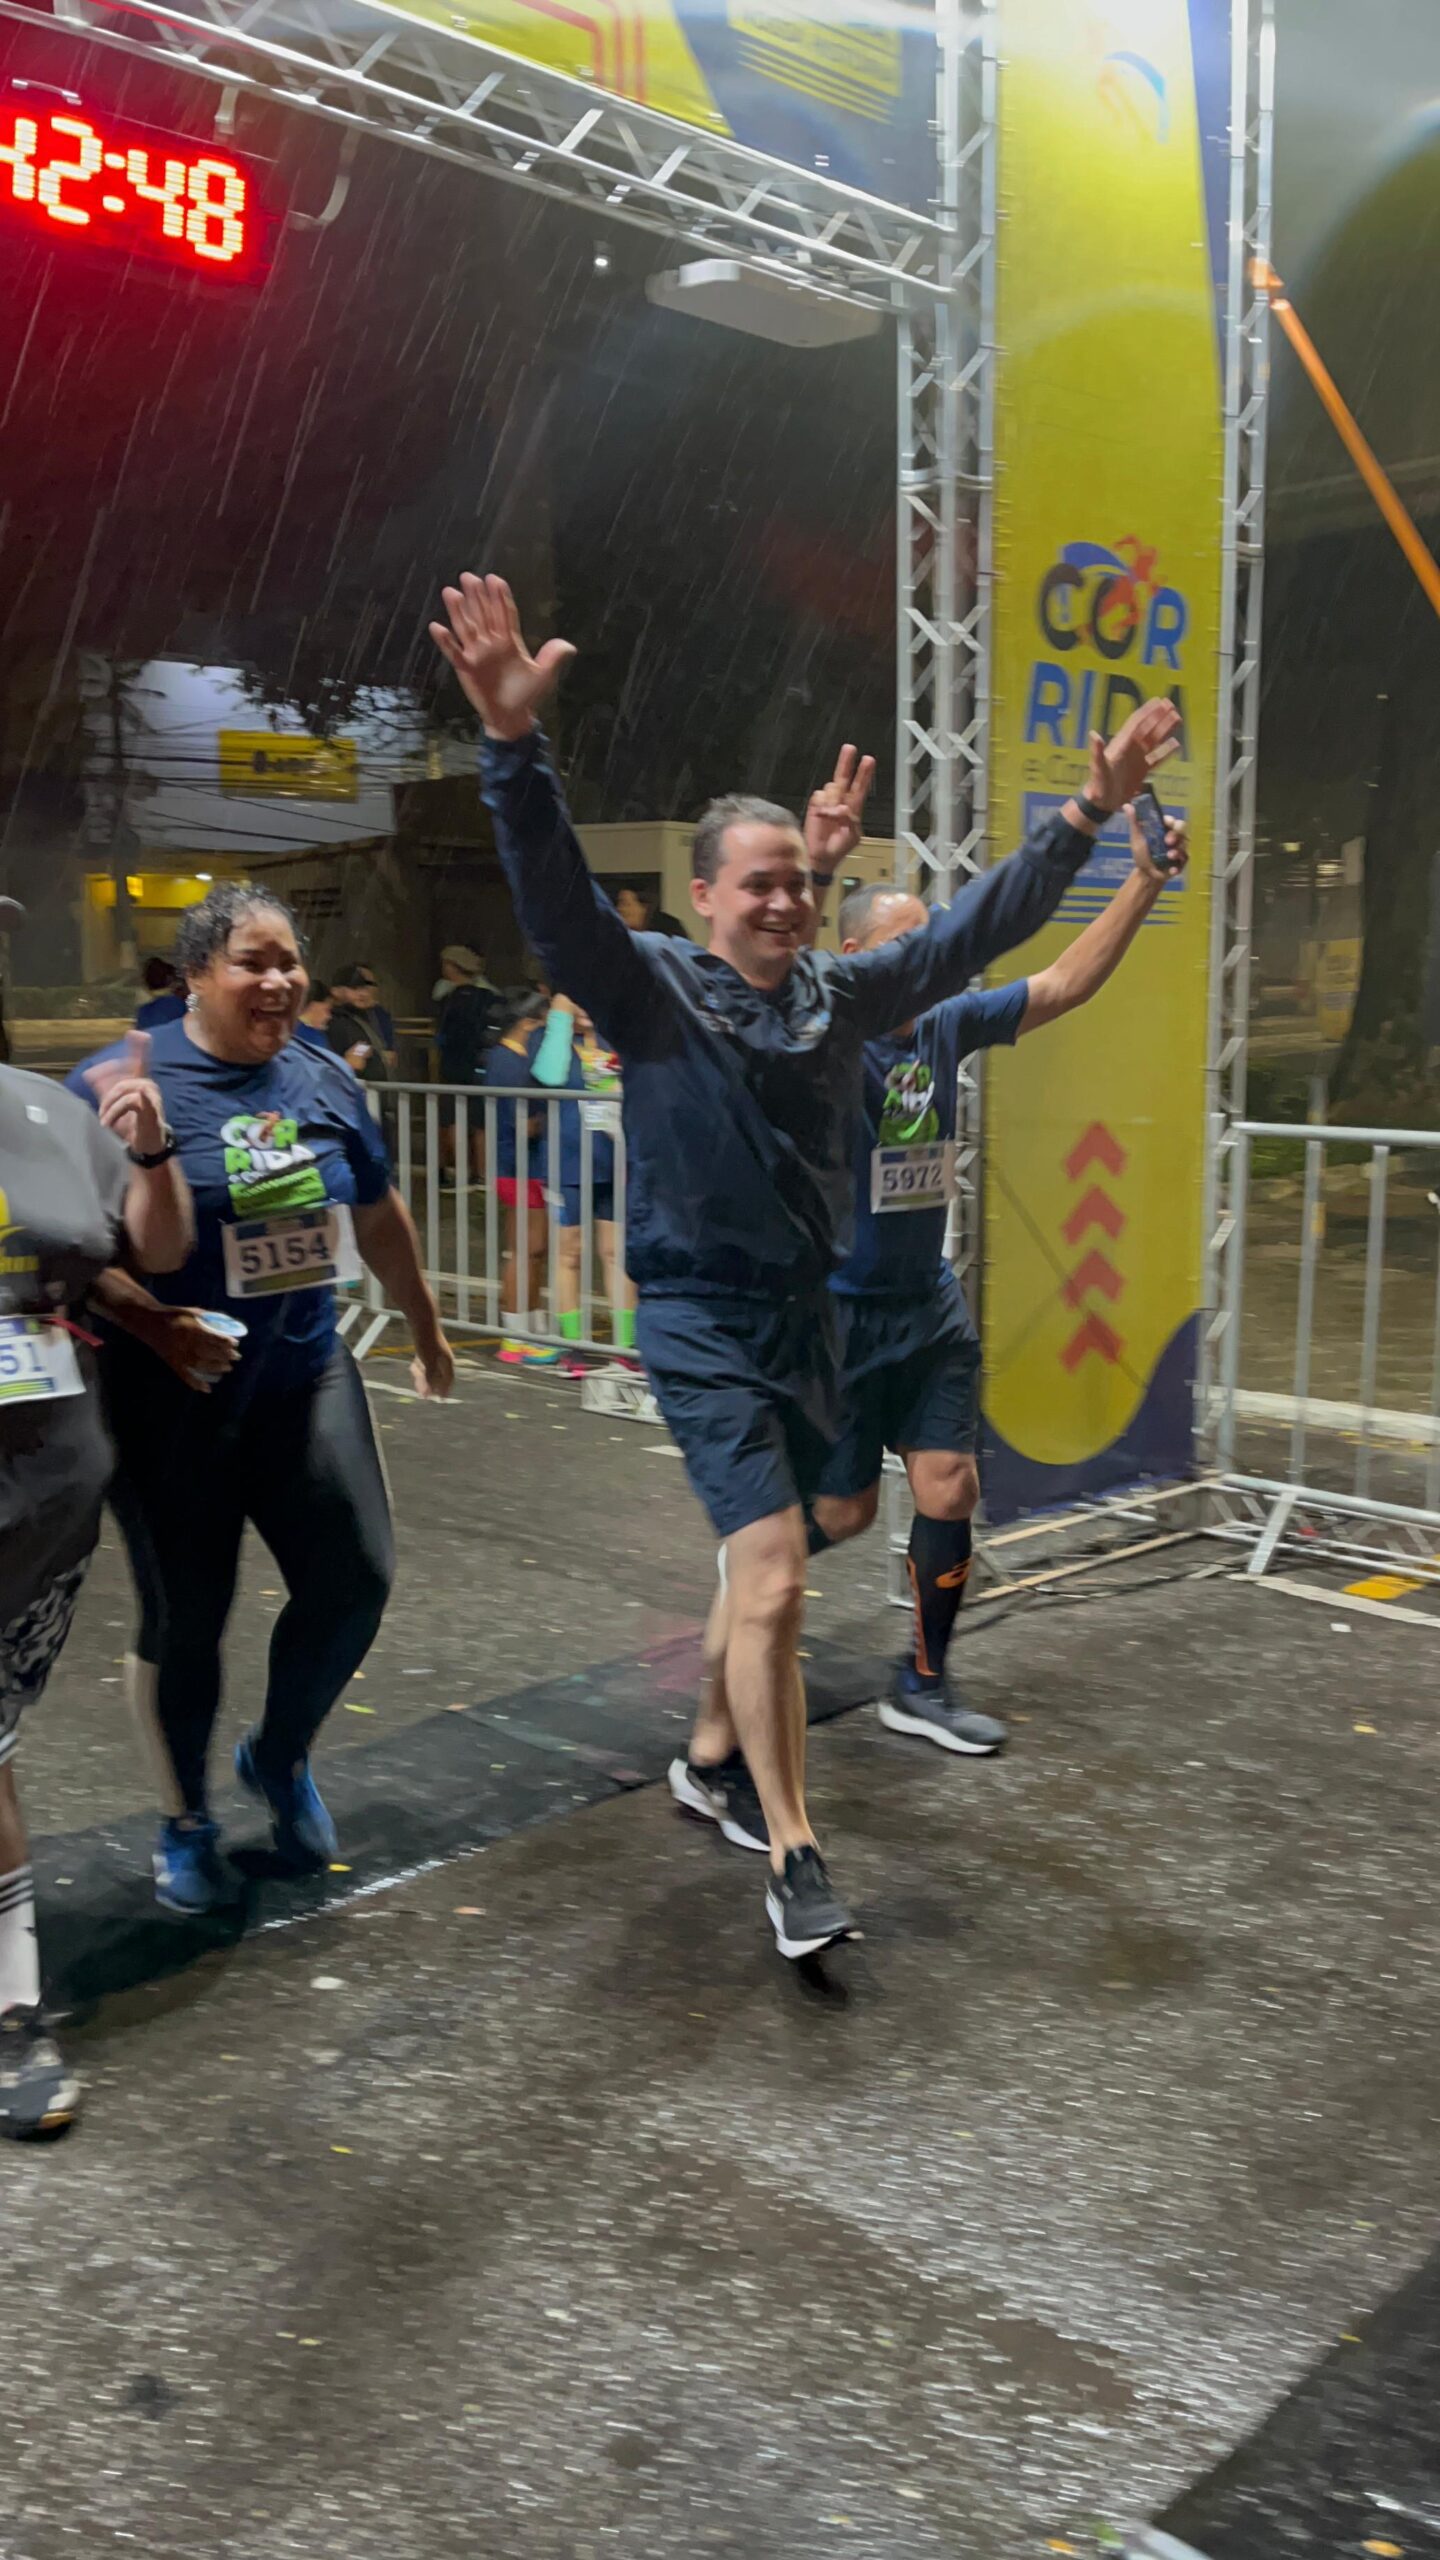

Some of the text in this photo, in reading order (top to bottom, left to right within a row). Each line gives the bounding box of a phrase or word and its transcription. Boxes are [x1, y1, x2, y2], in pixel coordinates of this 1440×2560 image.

[0, 117, 245, 261] 42:48
[1040, 563, 1187, 670] COR
[220, 1115, 299, 1149] COR
[224, 1143, 317, 1174] RIDA
[876, 1163, 942, 1192] 5972
[241, 1231, 331, 1275] 5154
